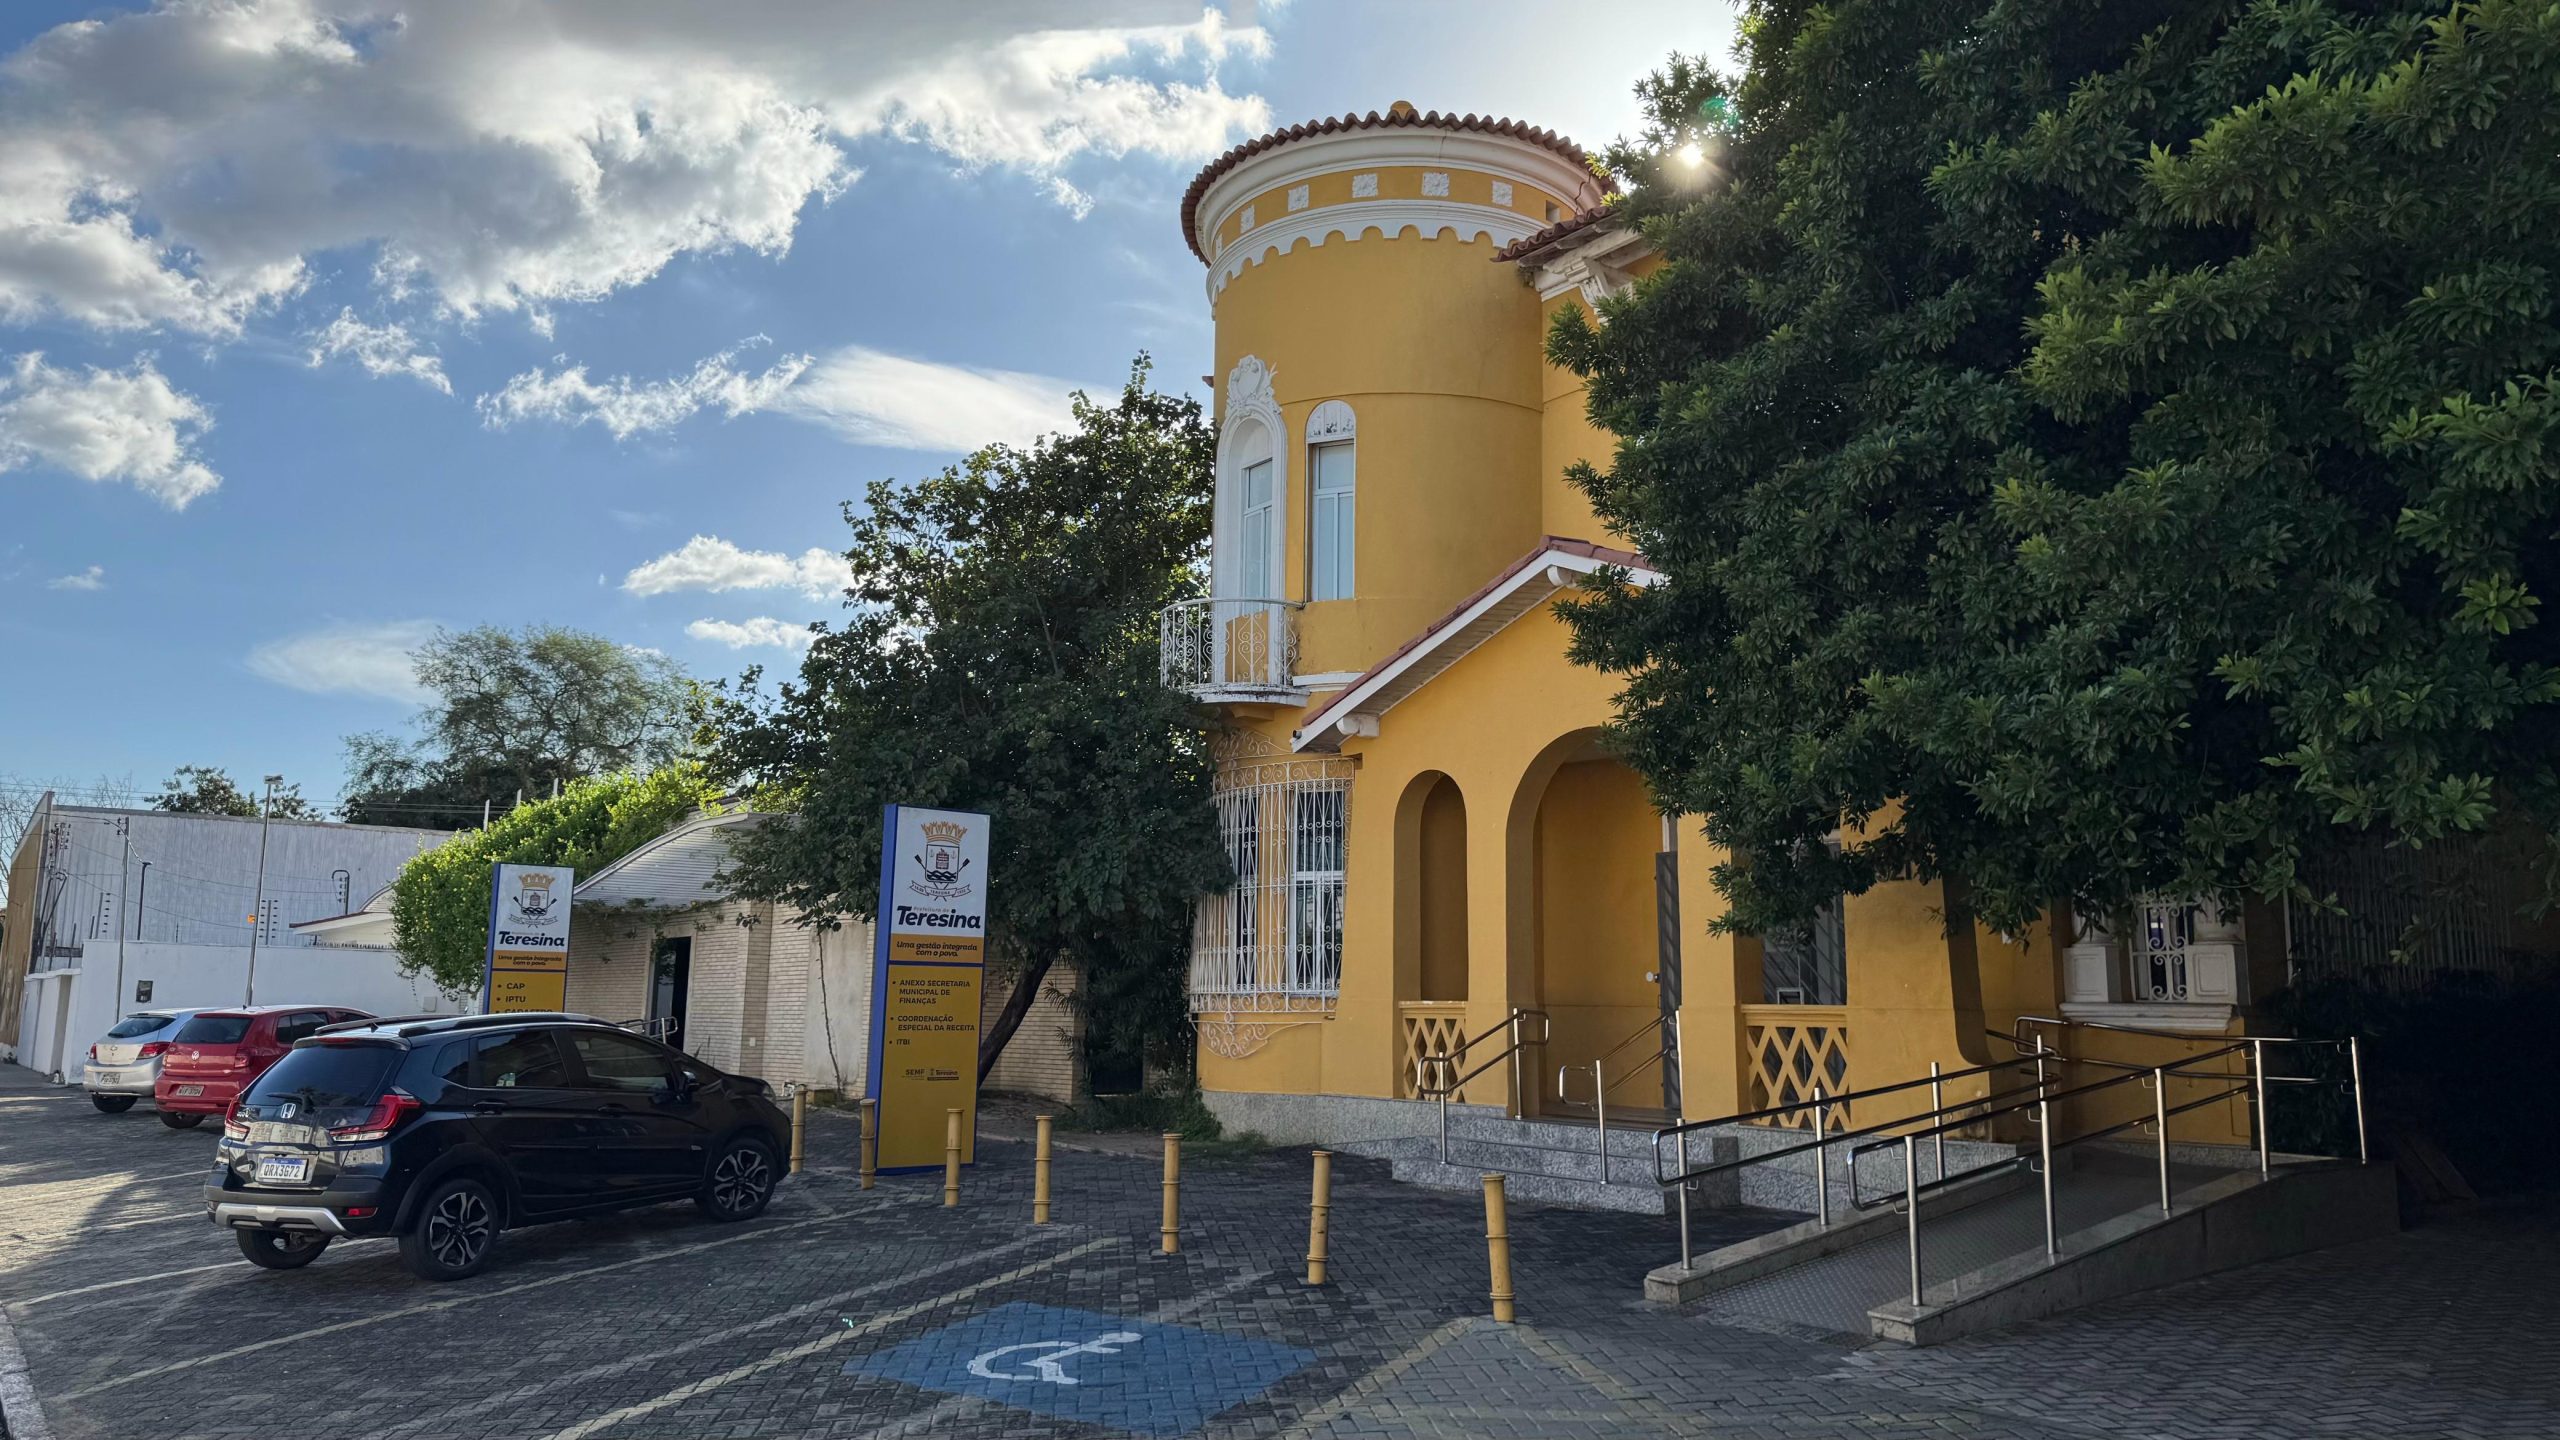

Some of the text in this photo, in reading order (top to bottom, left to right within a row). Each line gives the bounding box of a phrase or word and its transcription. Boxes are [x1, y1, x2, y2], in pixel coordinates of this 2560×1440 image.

[897, 905, 981, 928] Teresina
[498, 931, 565, 946] Teresina
[916, 942, 941, 950] gestão
[942, 943, 977, 951] integrada
[505, 995, 526, 1003] IPTU
[897, 1013, 954, 1022] COORDENAÇÃO
[263, 1164, 301, 1177] QRX3G72
